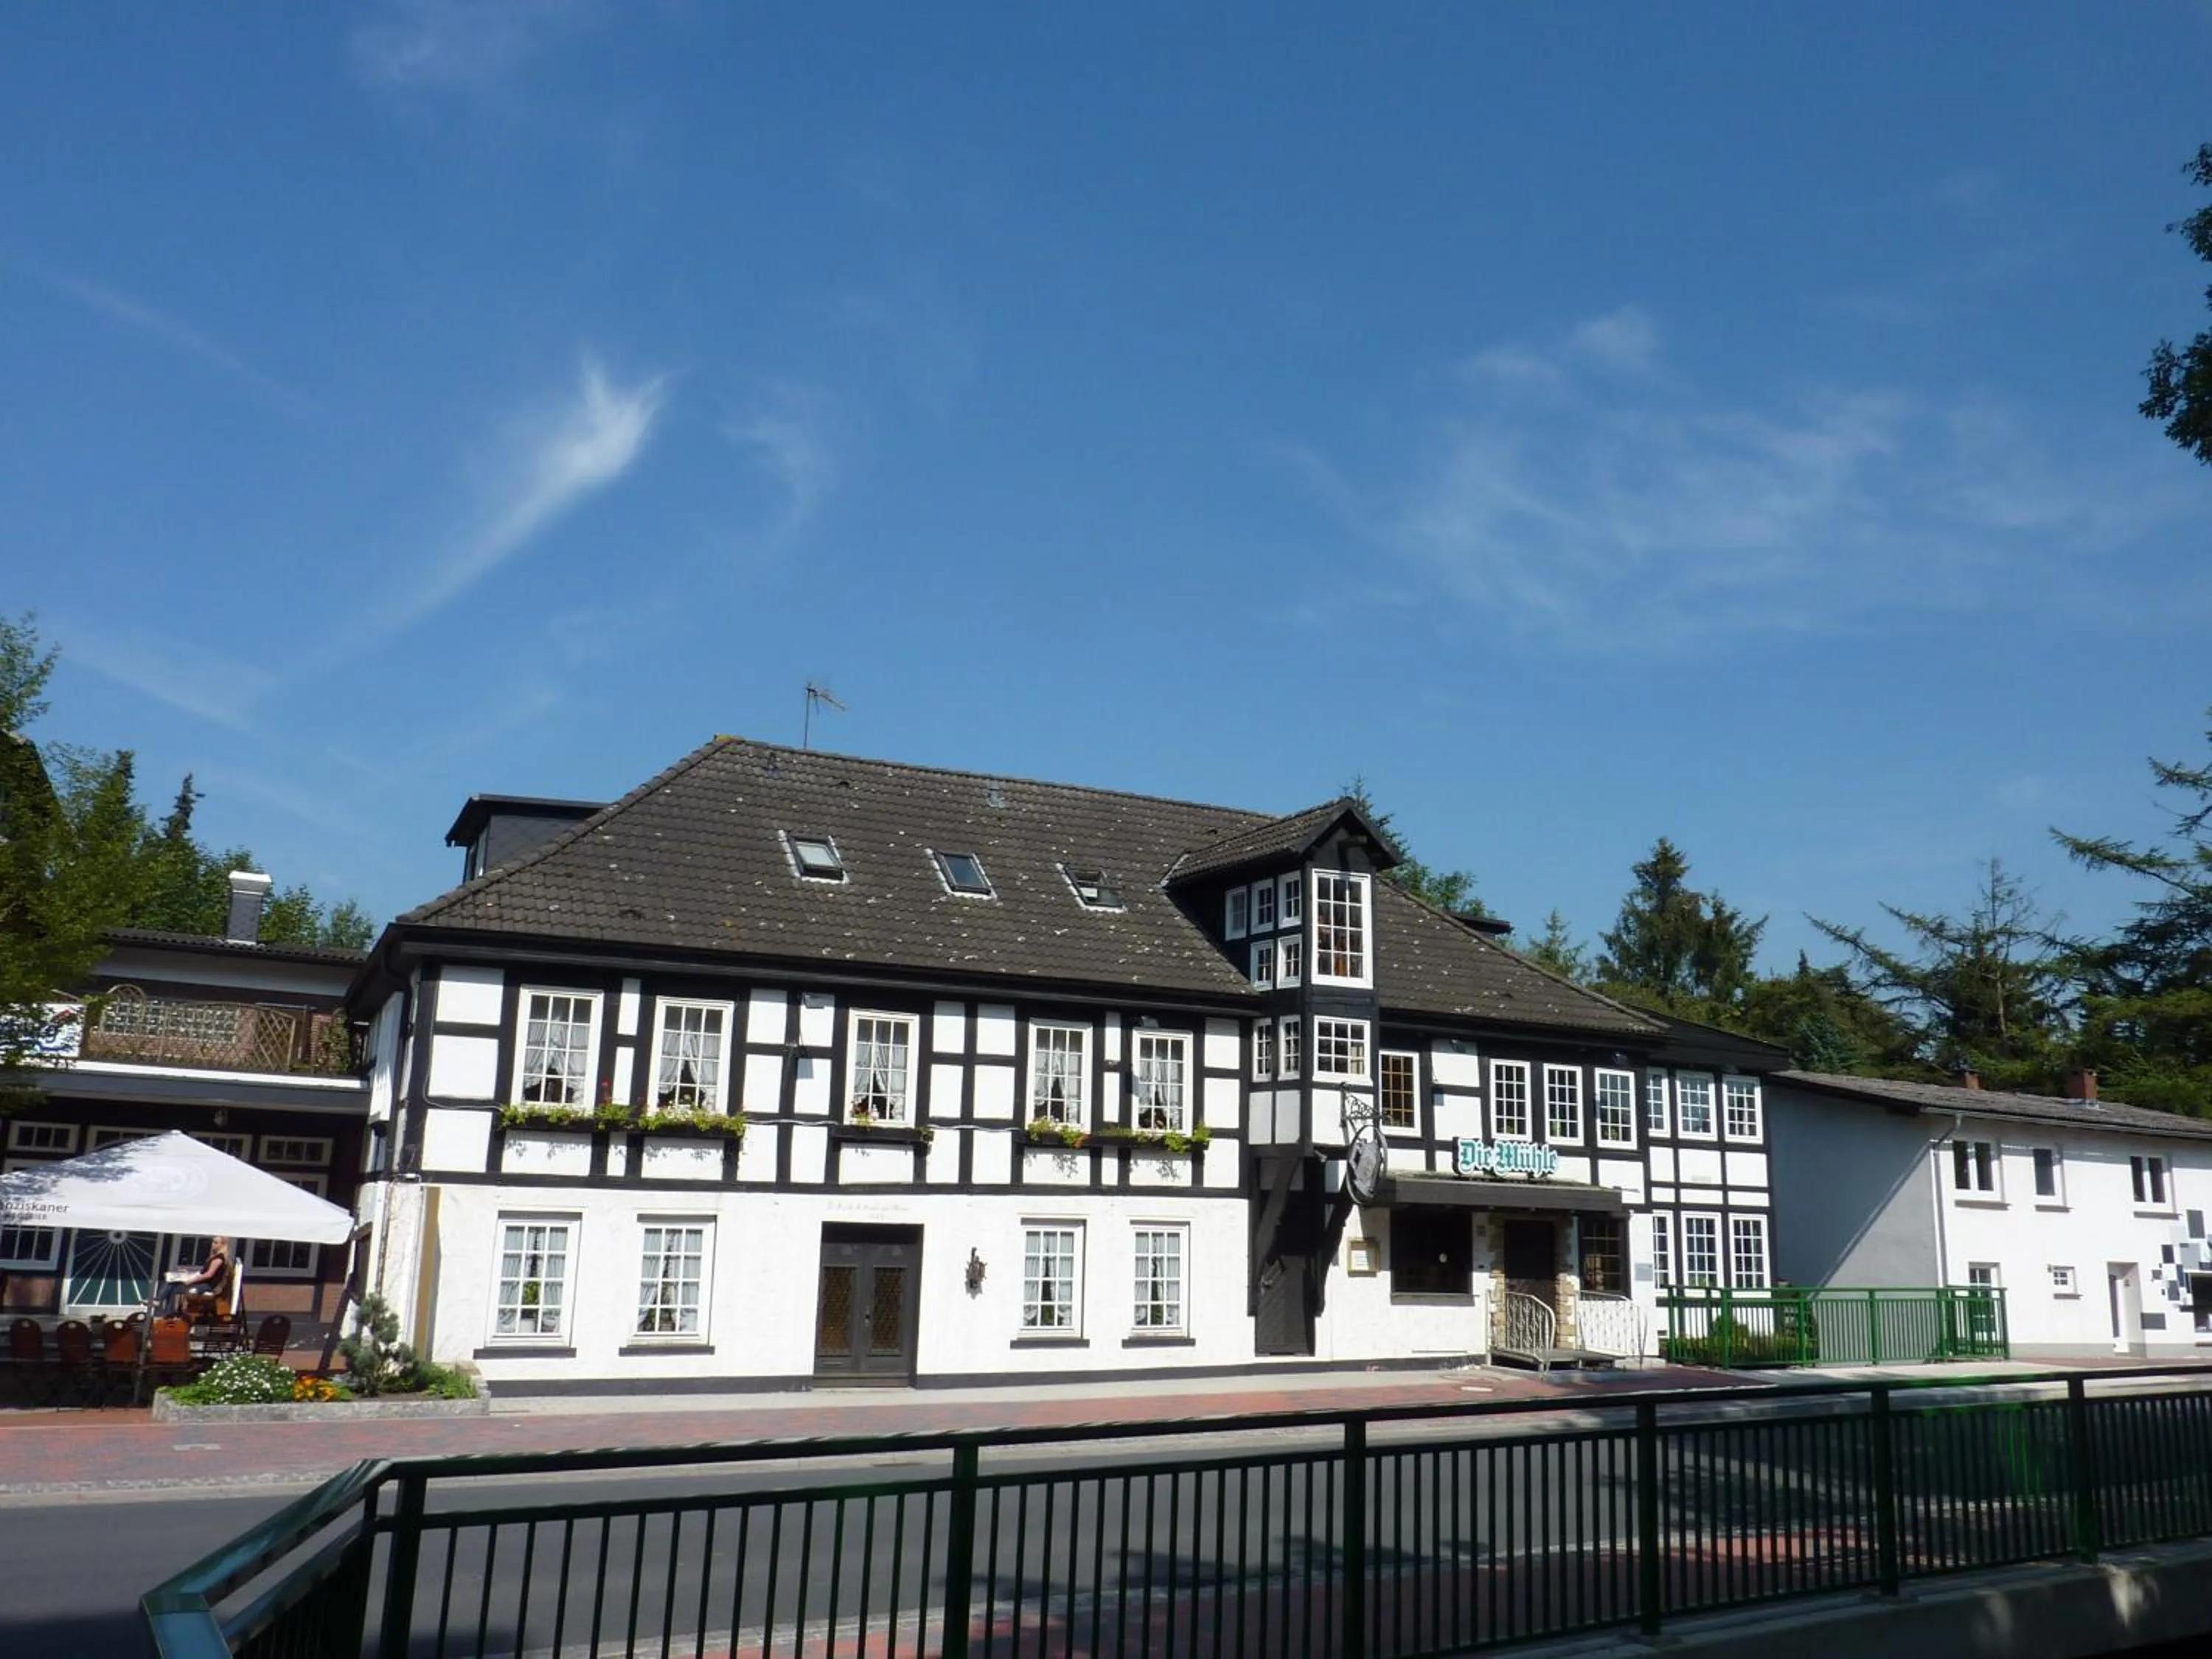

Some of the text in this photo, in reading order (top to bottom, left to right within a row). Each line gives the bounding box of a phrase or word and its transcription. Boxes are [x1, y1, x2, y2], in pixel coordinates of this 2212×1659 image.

[1460, 1140, 1558, 1177] Die Mühle
[0, 1200, 70, 1213] nziskaner
